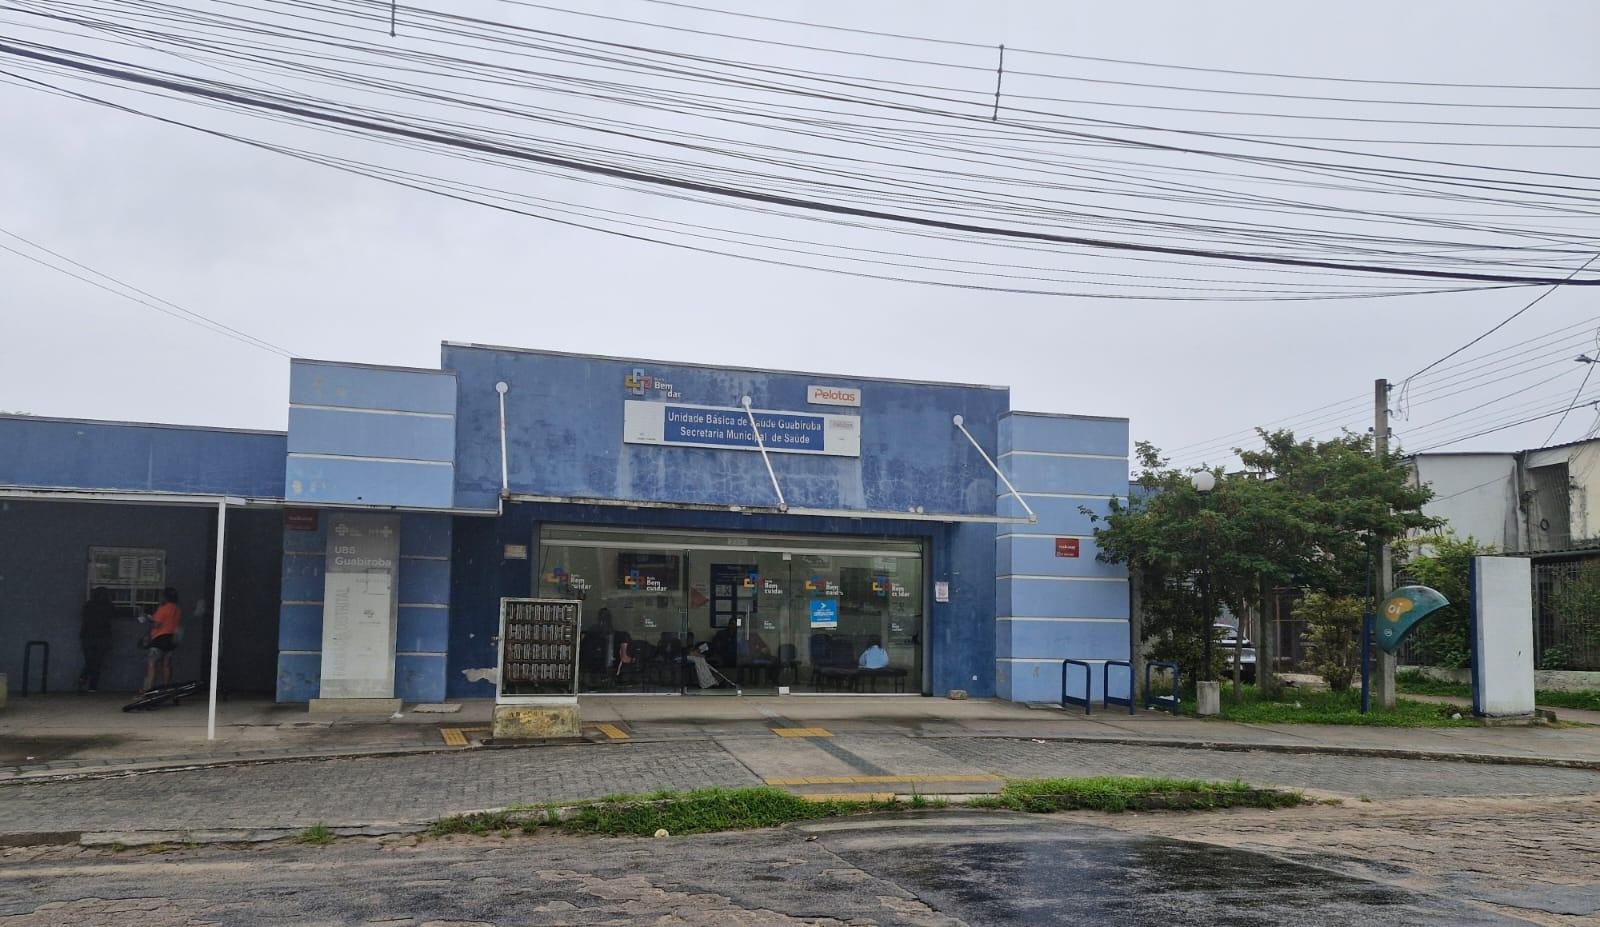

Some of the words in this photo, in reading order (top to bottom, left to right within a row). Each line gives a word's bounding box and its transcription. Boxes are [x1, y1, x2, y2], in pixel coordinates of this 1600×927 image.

[654, 381, 673, 390] Bem
[814, 388, 856, 402] Pelotas
[668, 411, 704, 423] Unidade
[706, 413, 735, 426] Básica
[737, 416, 748, 427] de
[778, 419, 821, 431] Guabiroba
[680, 426, 724, 439] Secretaria
[726, 430, 767, 444] Municipal
[771, 433, 782, 443] de
[334, 545, 356, 554] UBS
